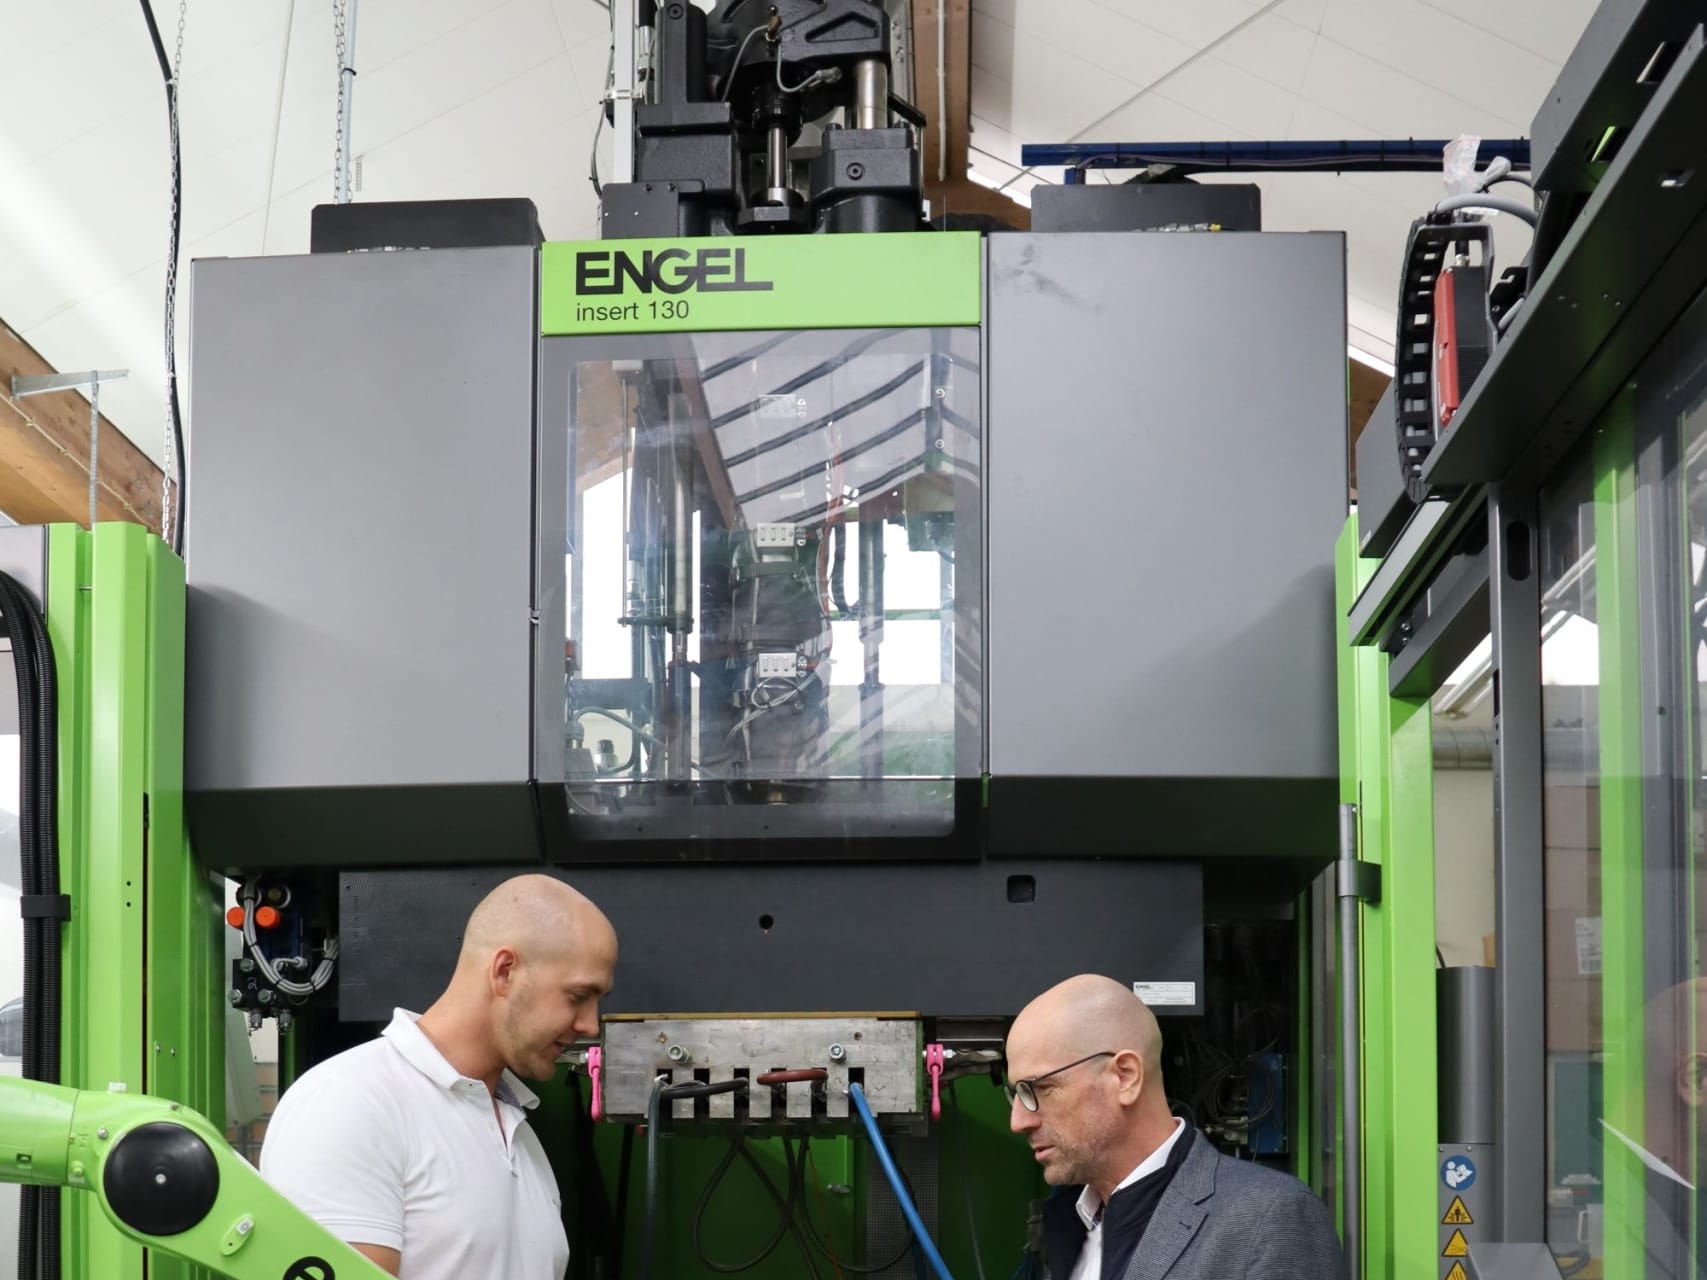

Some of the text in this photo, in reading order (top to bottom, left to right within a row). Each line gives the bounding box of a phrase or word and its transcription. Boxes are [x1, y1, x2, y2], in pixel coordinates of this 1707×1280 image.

[576, 248, 774, 296] ENGEL
[576, 300, 690, 321] insert 130
